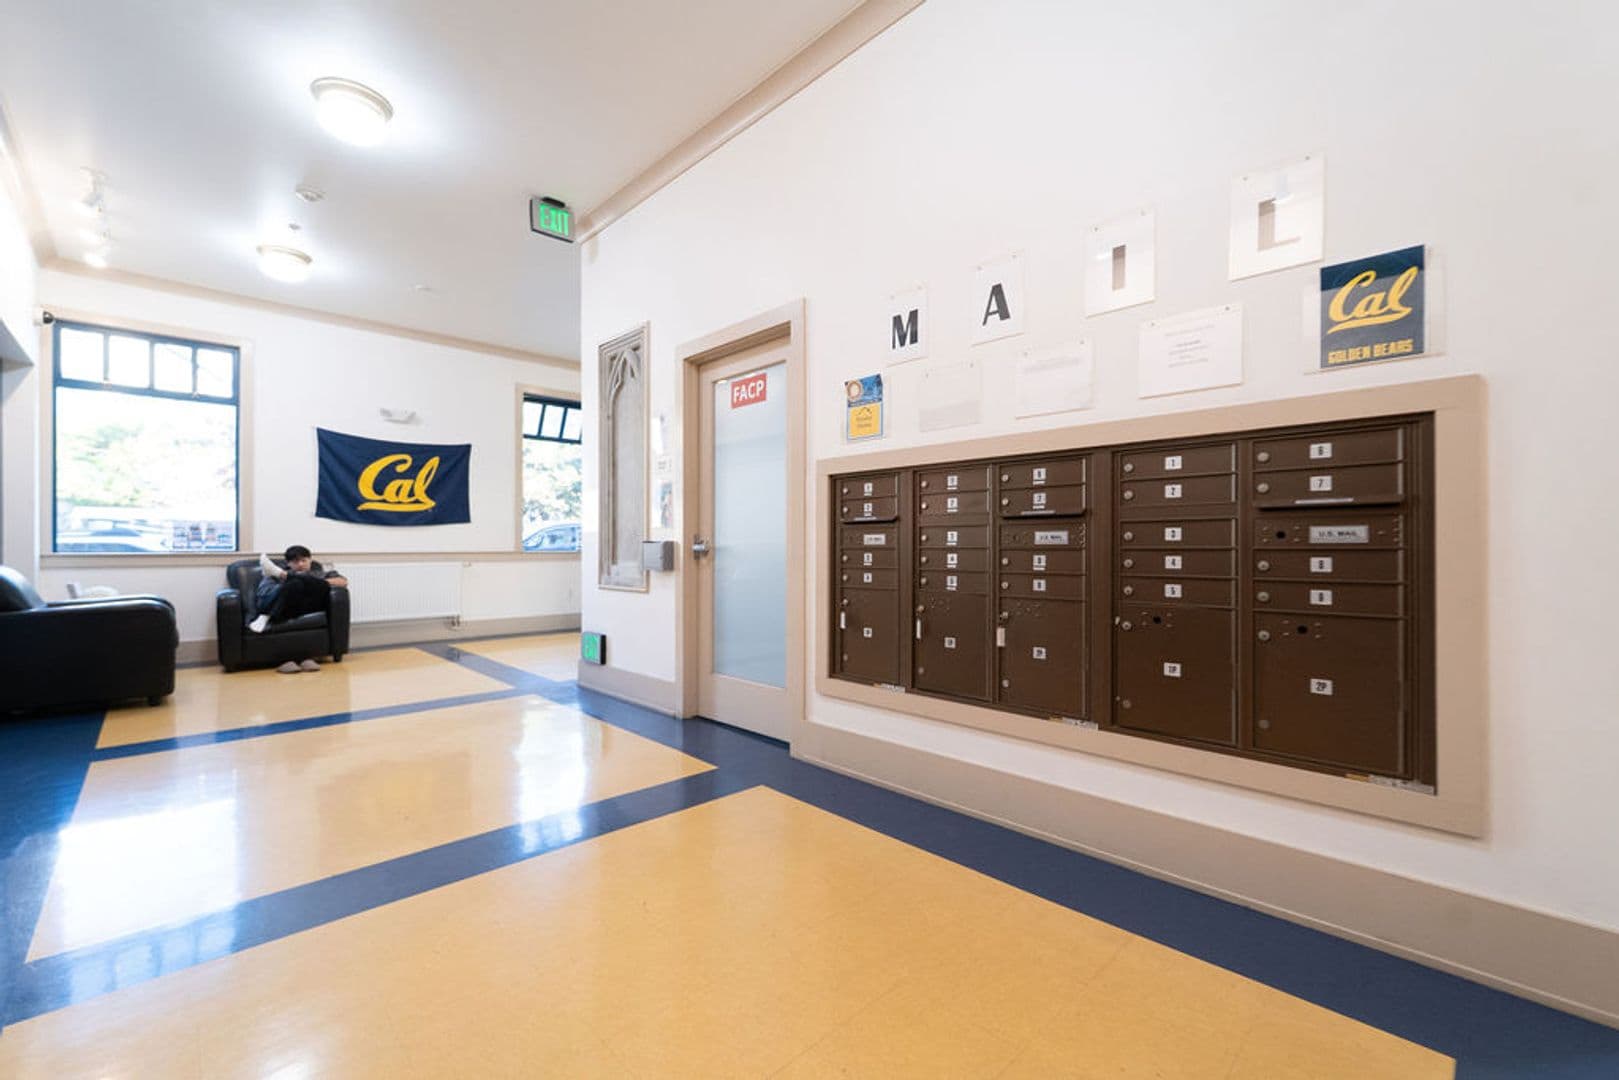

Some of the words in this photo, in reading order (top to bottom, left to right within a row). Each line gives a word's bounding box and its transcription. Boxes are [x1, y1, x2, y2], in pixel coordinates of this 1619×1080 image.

[539, 203, 569, 238] EXIT
[892, 308, 919, 350] M
[982, 283, 1011, 326] A
[1112, 244, 1126, 291] I
[1257, 198, 1301, 251] L
[1326, 266, 1419, 335] Cal
[1327, 345, 1371, 364] GOLDEN
[1373, 338, 1414, 357] BEARS
[733, 379, 766, 404] FACP
[356, 453, 440, 512] Cal
